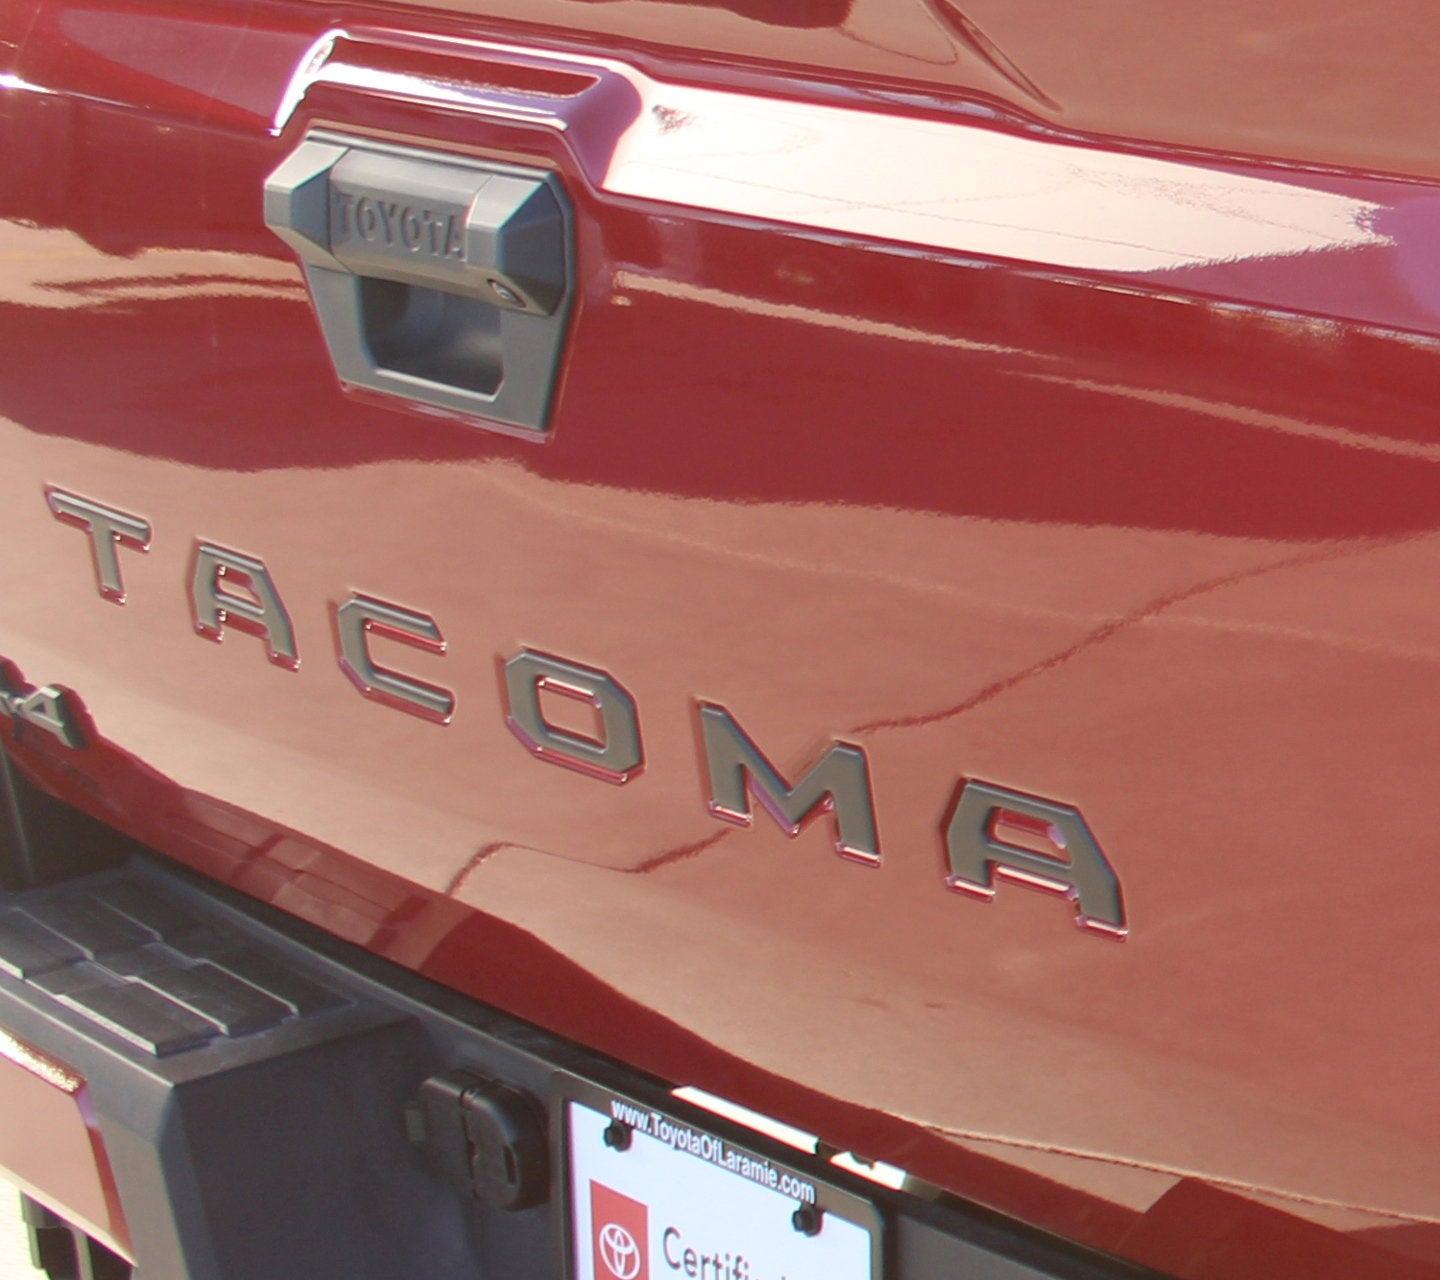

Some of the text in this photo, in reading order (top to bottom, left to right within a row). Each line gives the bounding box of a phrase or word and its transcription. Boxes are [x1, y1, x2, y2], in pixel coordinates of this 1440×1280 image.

[334, 191, 468, 263] TOYOTA
[42, 482, 1129, 943] TACOMA
[610, 1099, 816, 1205] www.ToyotaOfLaramie.com
